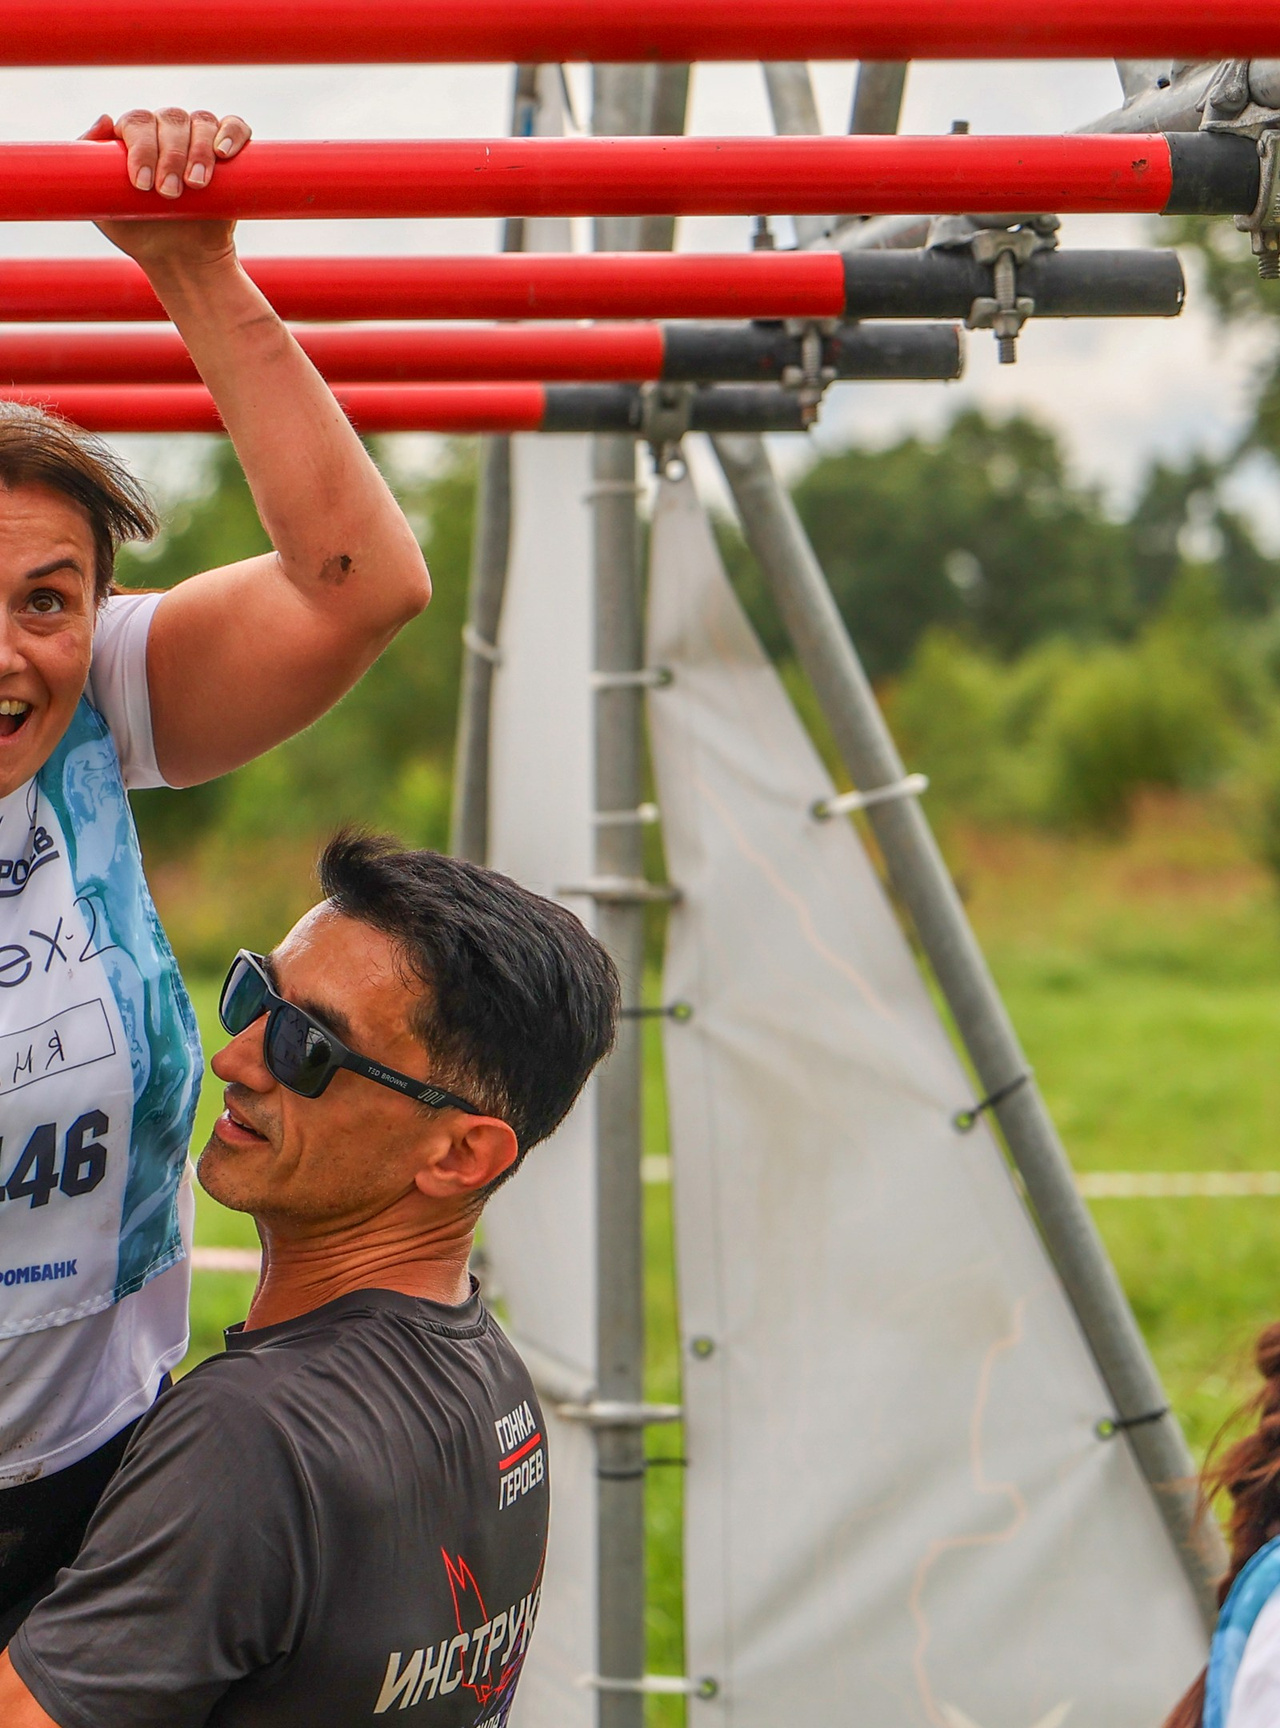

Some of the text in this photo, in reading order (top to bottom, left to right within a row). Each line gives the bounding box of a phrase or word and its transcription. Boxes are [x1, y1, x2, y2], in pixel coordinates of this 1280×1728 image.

[367, 1066, 408, 1089] TED BROWNE
[494, 1400, 536, 1454] ГОНКА
[499, 1448, 545, 1511] ГЕРОЕВ
